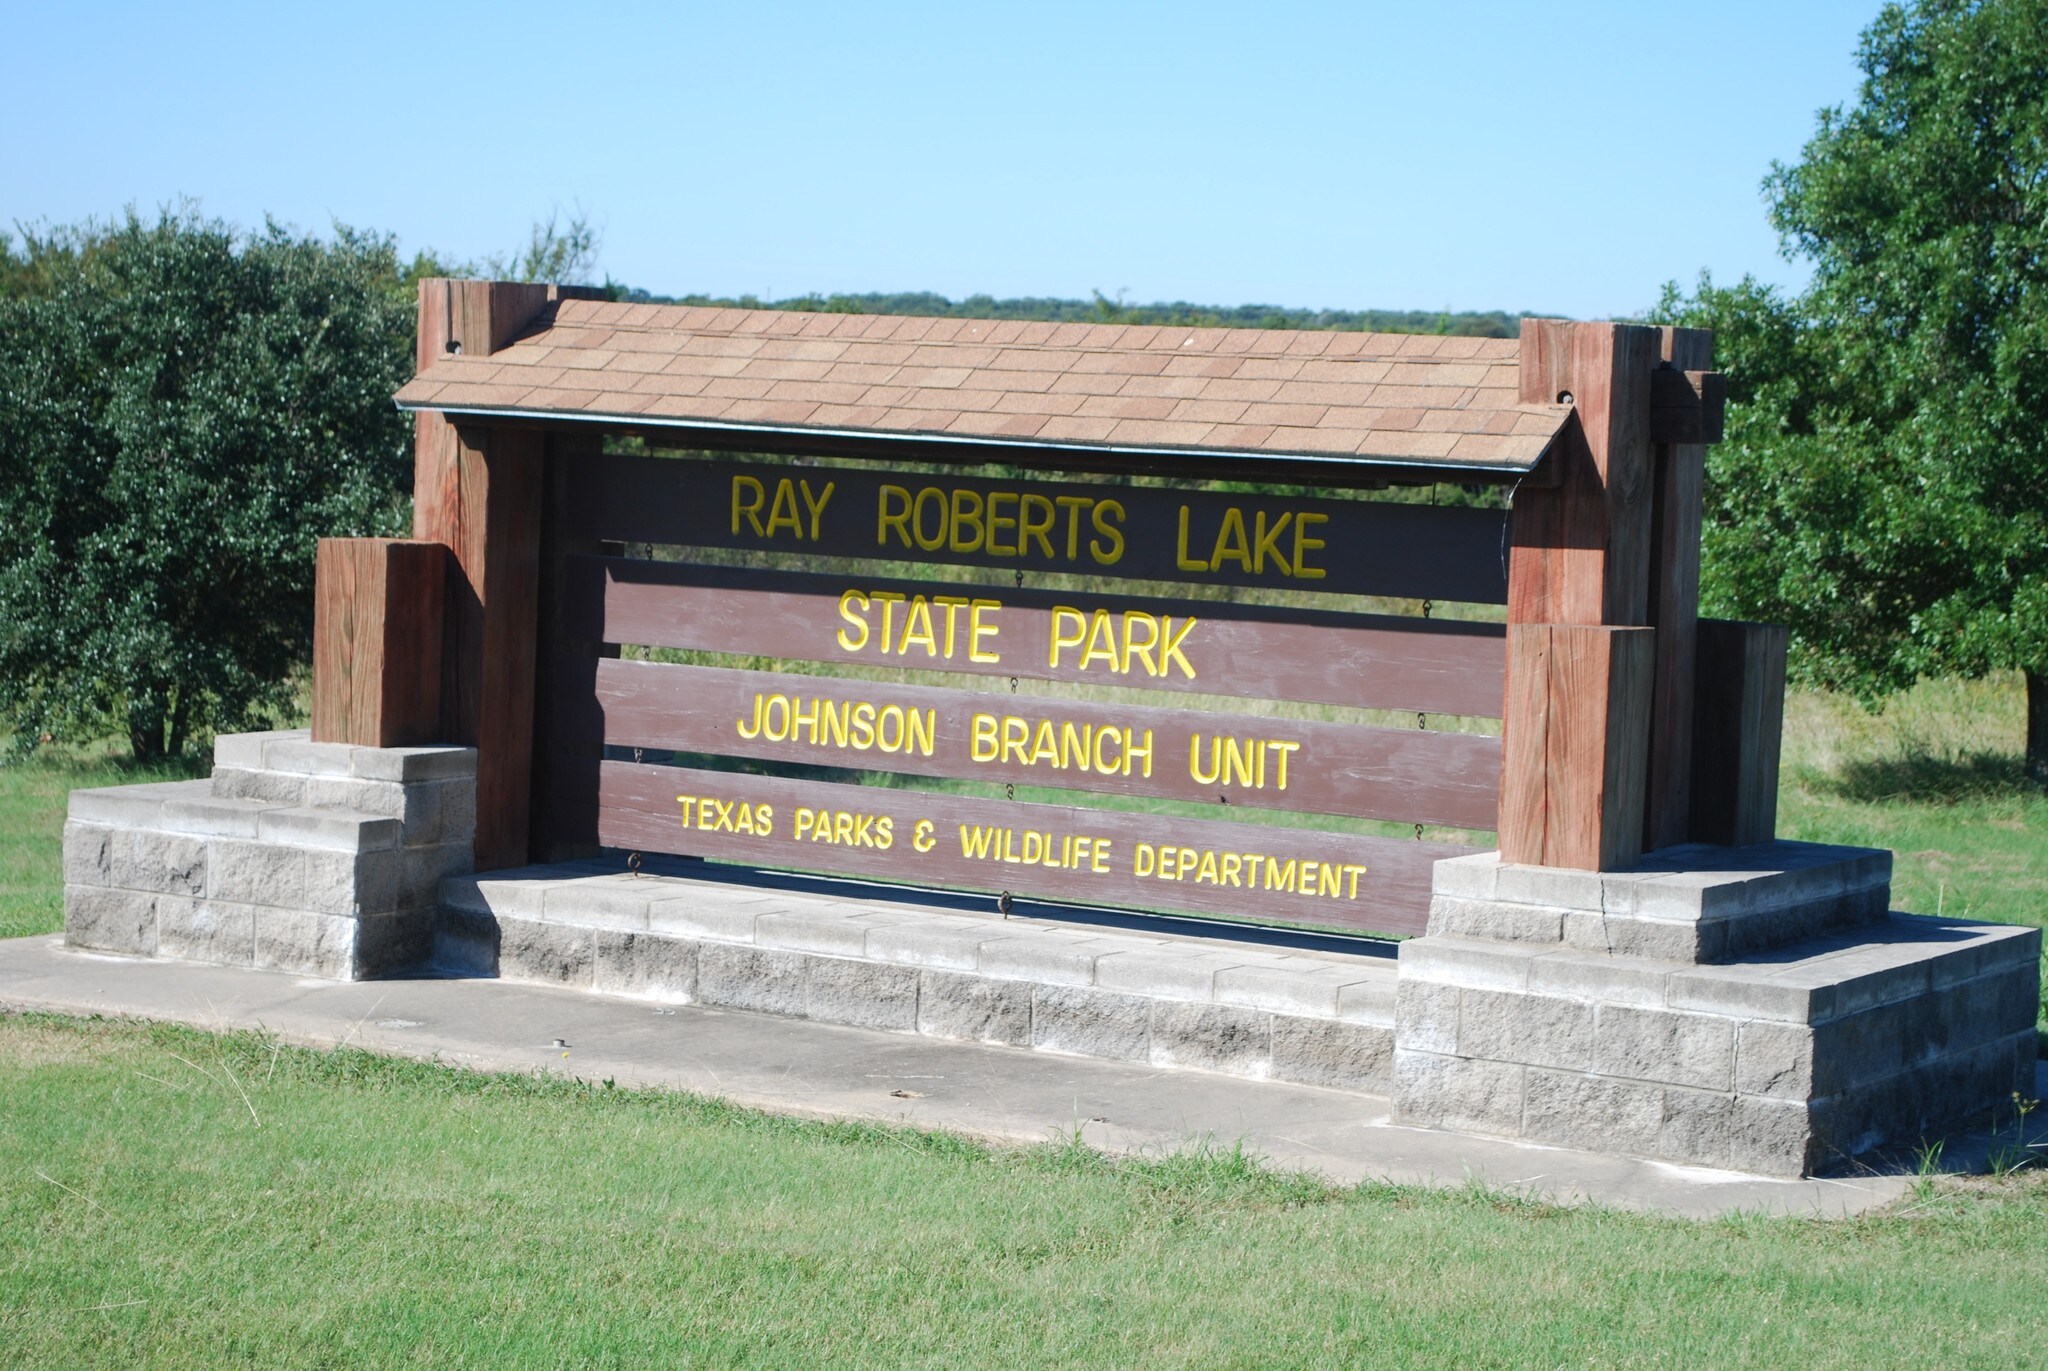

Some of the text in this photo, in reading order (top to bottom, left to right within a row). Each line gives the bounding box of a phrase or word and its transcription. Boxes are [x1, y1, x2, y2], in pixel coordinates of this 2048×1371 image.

[731, 475, 1329, 579] RAY ROBERTS LAKE
[836, 588, 1198, 679] STATE PARK
[736, 693, 1300, 790] JOHNSON BRANCH UNIT
[676, 795, 1367, 900] TEXAS PARKS & WILDLIFE DEPARTMENT
